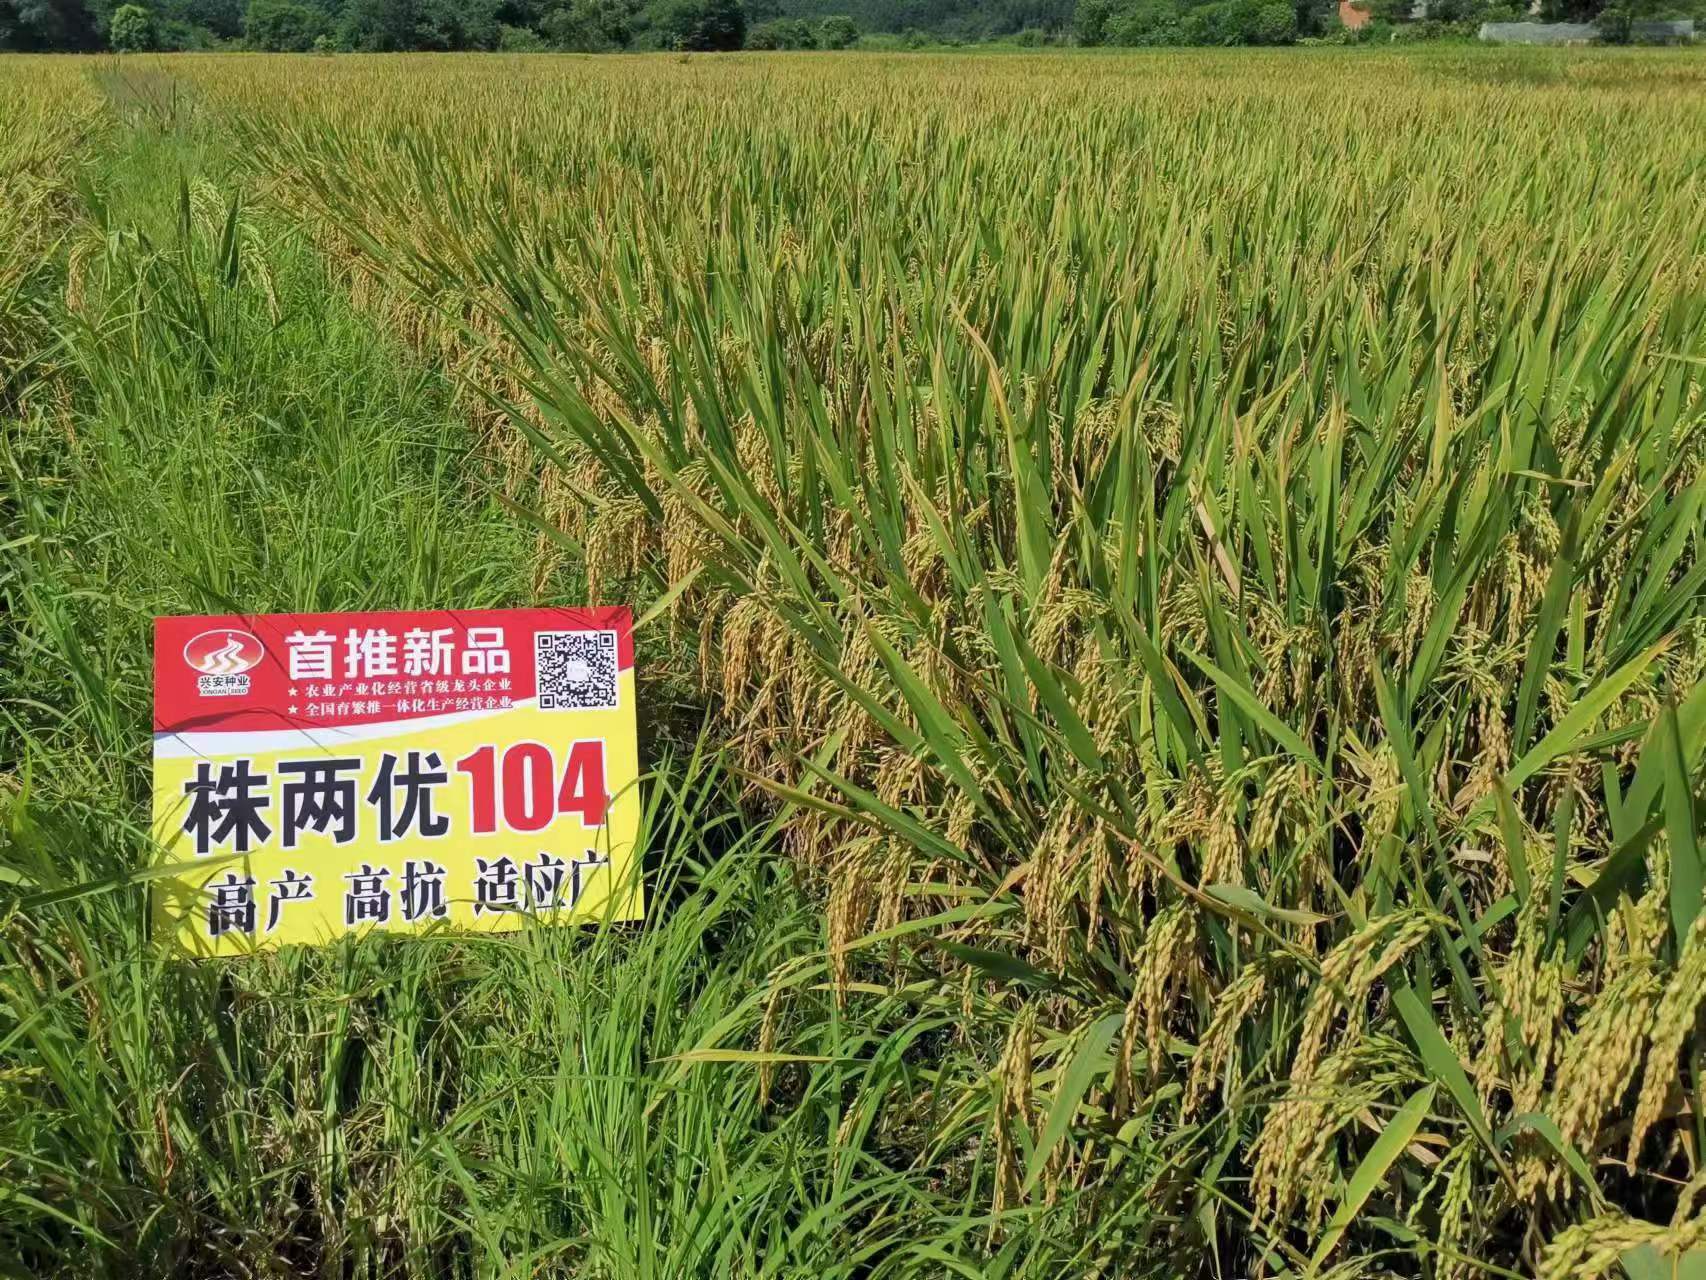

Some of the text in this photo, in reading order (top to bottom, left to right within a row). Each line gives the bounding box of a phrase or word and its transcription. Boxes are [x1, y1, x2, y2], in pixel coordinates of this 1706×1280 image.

[285, 627, 511, 681] 首推新品
[200, 675, 249, 687] 兴安种业
[305, 678, 512, 698] 农业产业化经营省级龙头企业
[305, 695, 513, 718] 全国育繁推一体化生产经营企业
[208, 850, 609, 937] 高产 高抗 适应广
